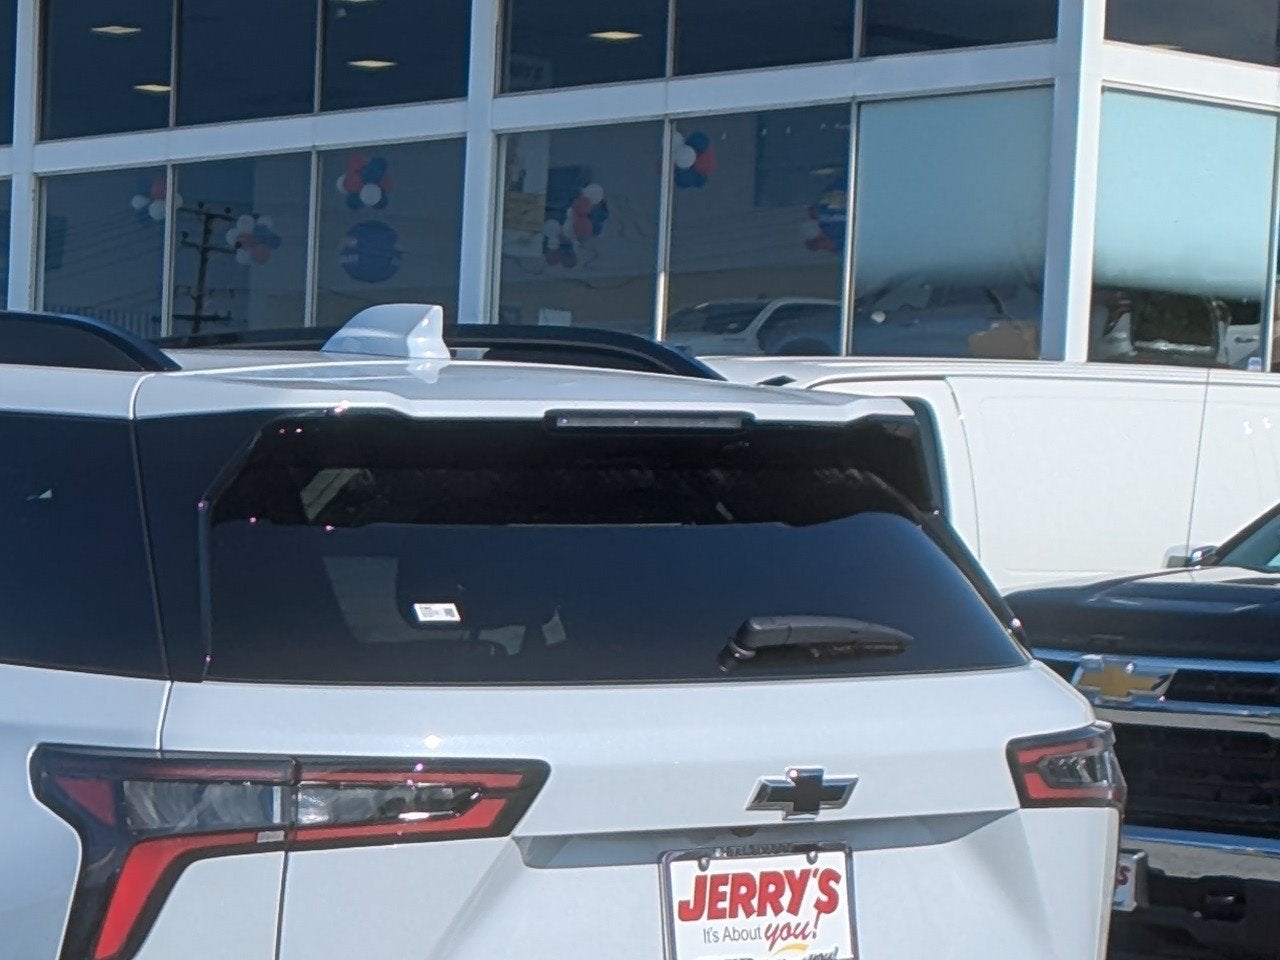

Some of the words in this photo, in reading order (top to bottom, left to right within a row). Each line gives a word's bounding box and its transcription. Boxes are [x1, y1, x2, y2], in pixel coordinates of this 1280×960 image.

[677, 867, 842, 922] JERRY'S
[703, 926, 720, 944] It's
[722, 923, 762, 942] About
[764, 911, 820, 953] you!
